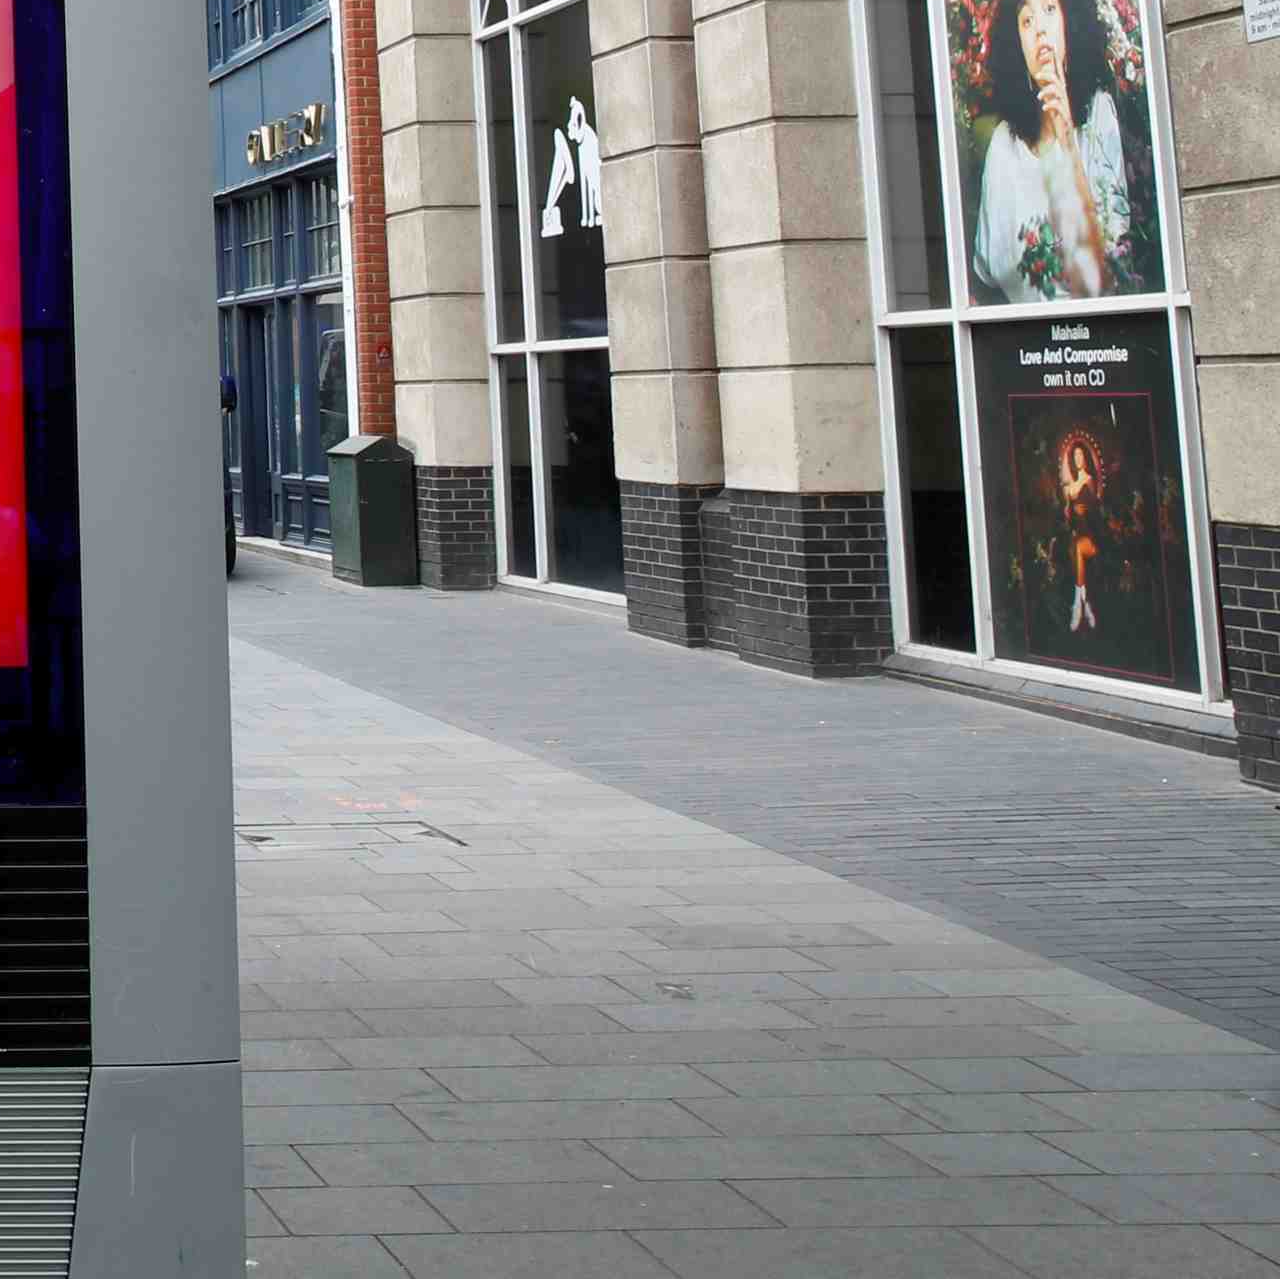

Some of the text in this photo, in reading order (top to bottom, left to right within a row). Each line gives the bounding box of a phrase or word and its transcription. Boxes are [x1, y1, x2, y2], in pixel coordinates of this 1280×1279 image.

[1051, 324, 1090, 340] Mahalia
[1020, 345, 1128, 365] Love And Compromise
[1044, 369, 1104, 386] own it on CD
